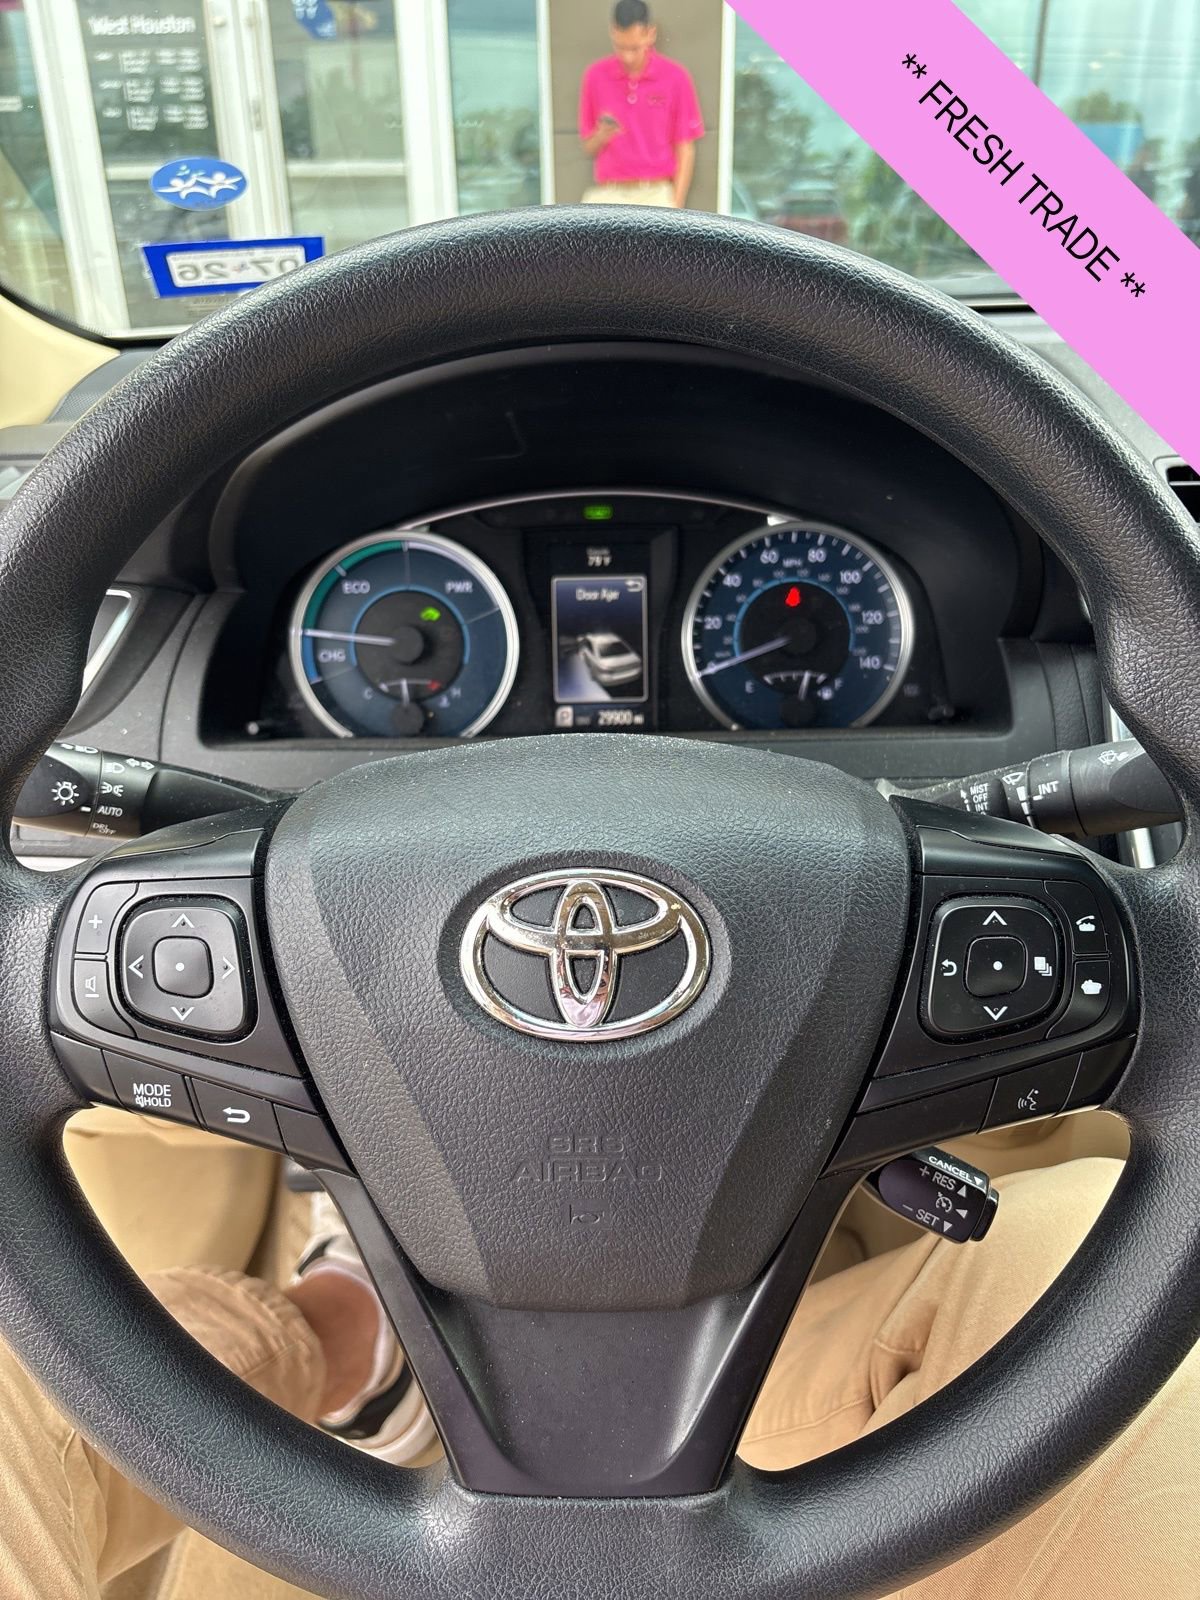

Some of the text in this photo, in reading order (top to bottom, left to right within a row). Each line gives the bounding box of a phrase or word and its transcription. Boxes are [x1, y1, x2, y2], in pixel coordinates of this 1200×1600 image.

[88, 14, 196, 35] West Houston
[760, 550, 827, 564] 60 80
[723, 573, 742, 588] 40
[840, 570, 862, 584] 100
[342, 581, 370, 594] ECO
[445, 581, 473, 594] PWR
[704, 616, 722, 630] 20
[862, 610, 884, 624] 120
[318, 651, 346, 662] CHG
[860, 656, 881, 670] 140
[970, 782, 989, 795] MIST
[1038, 780, 1060, 795] INT
[972, 793, 989, 803] OFF
[97, 805, 123, 817] AUTO
[975, 802, 988, 812] INT
[133, 1082, 171, 1097] MODE
[143, 1096, 172, 1108] HOLD
[549, 1134, 626, 1153] SRS
[511, 1160, 664, 1183] AIRBAG
[928, 1155, 973, 1182] CANCEL
[932, 1171, 957, 1190] RES
[915, 1208, 940, 1227] SET
